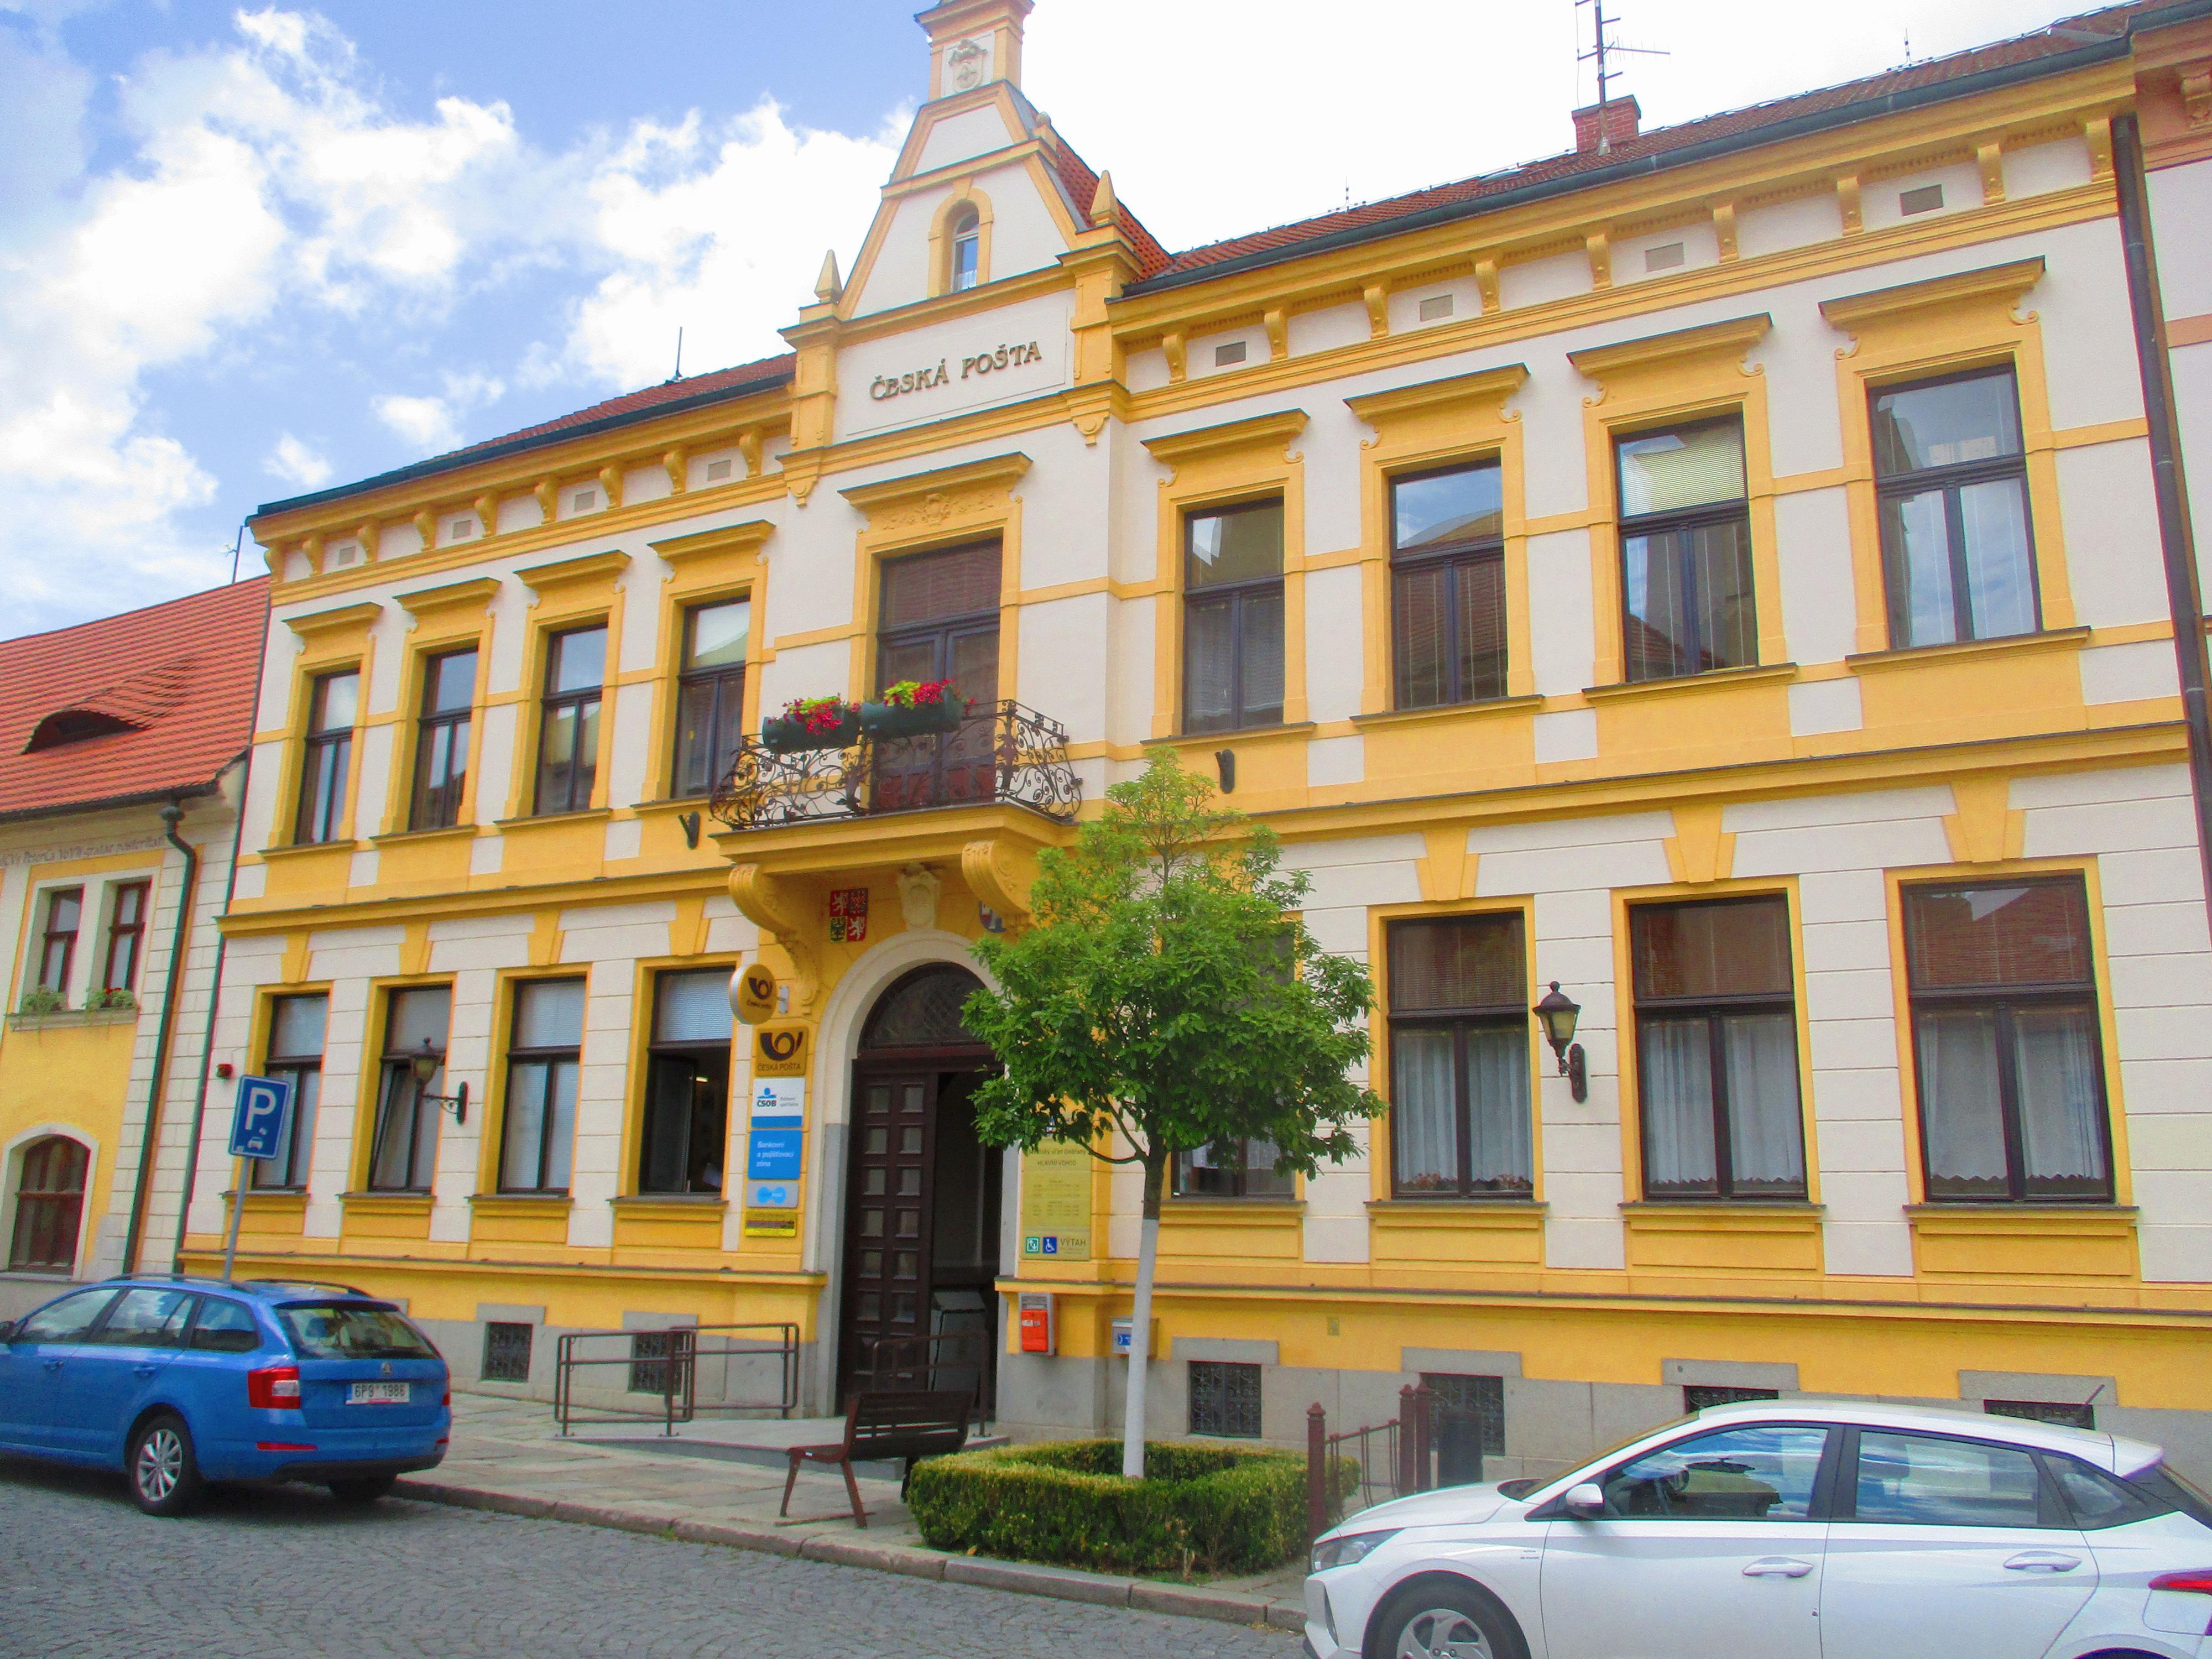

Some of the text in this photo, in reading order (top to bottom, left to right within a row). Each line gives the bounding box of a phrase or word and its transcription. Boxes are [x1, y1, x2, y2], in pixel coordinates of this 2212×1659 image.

[869, 341, 1042, 400] ČESKÁ POŠTA
[757, 1062, 801, 1071] ČESKÁ POŠTA
[244, 1087, 276, 1130] P
[1060, 1237, 1086, 1246] VÝTAH
[354, 1384, 374, 1398] 6P9
